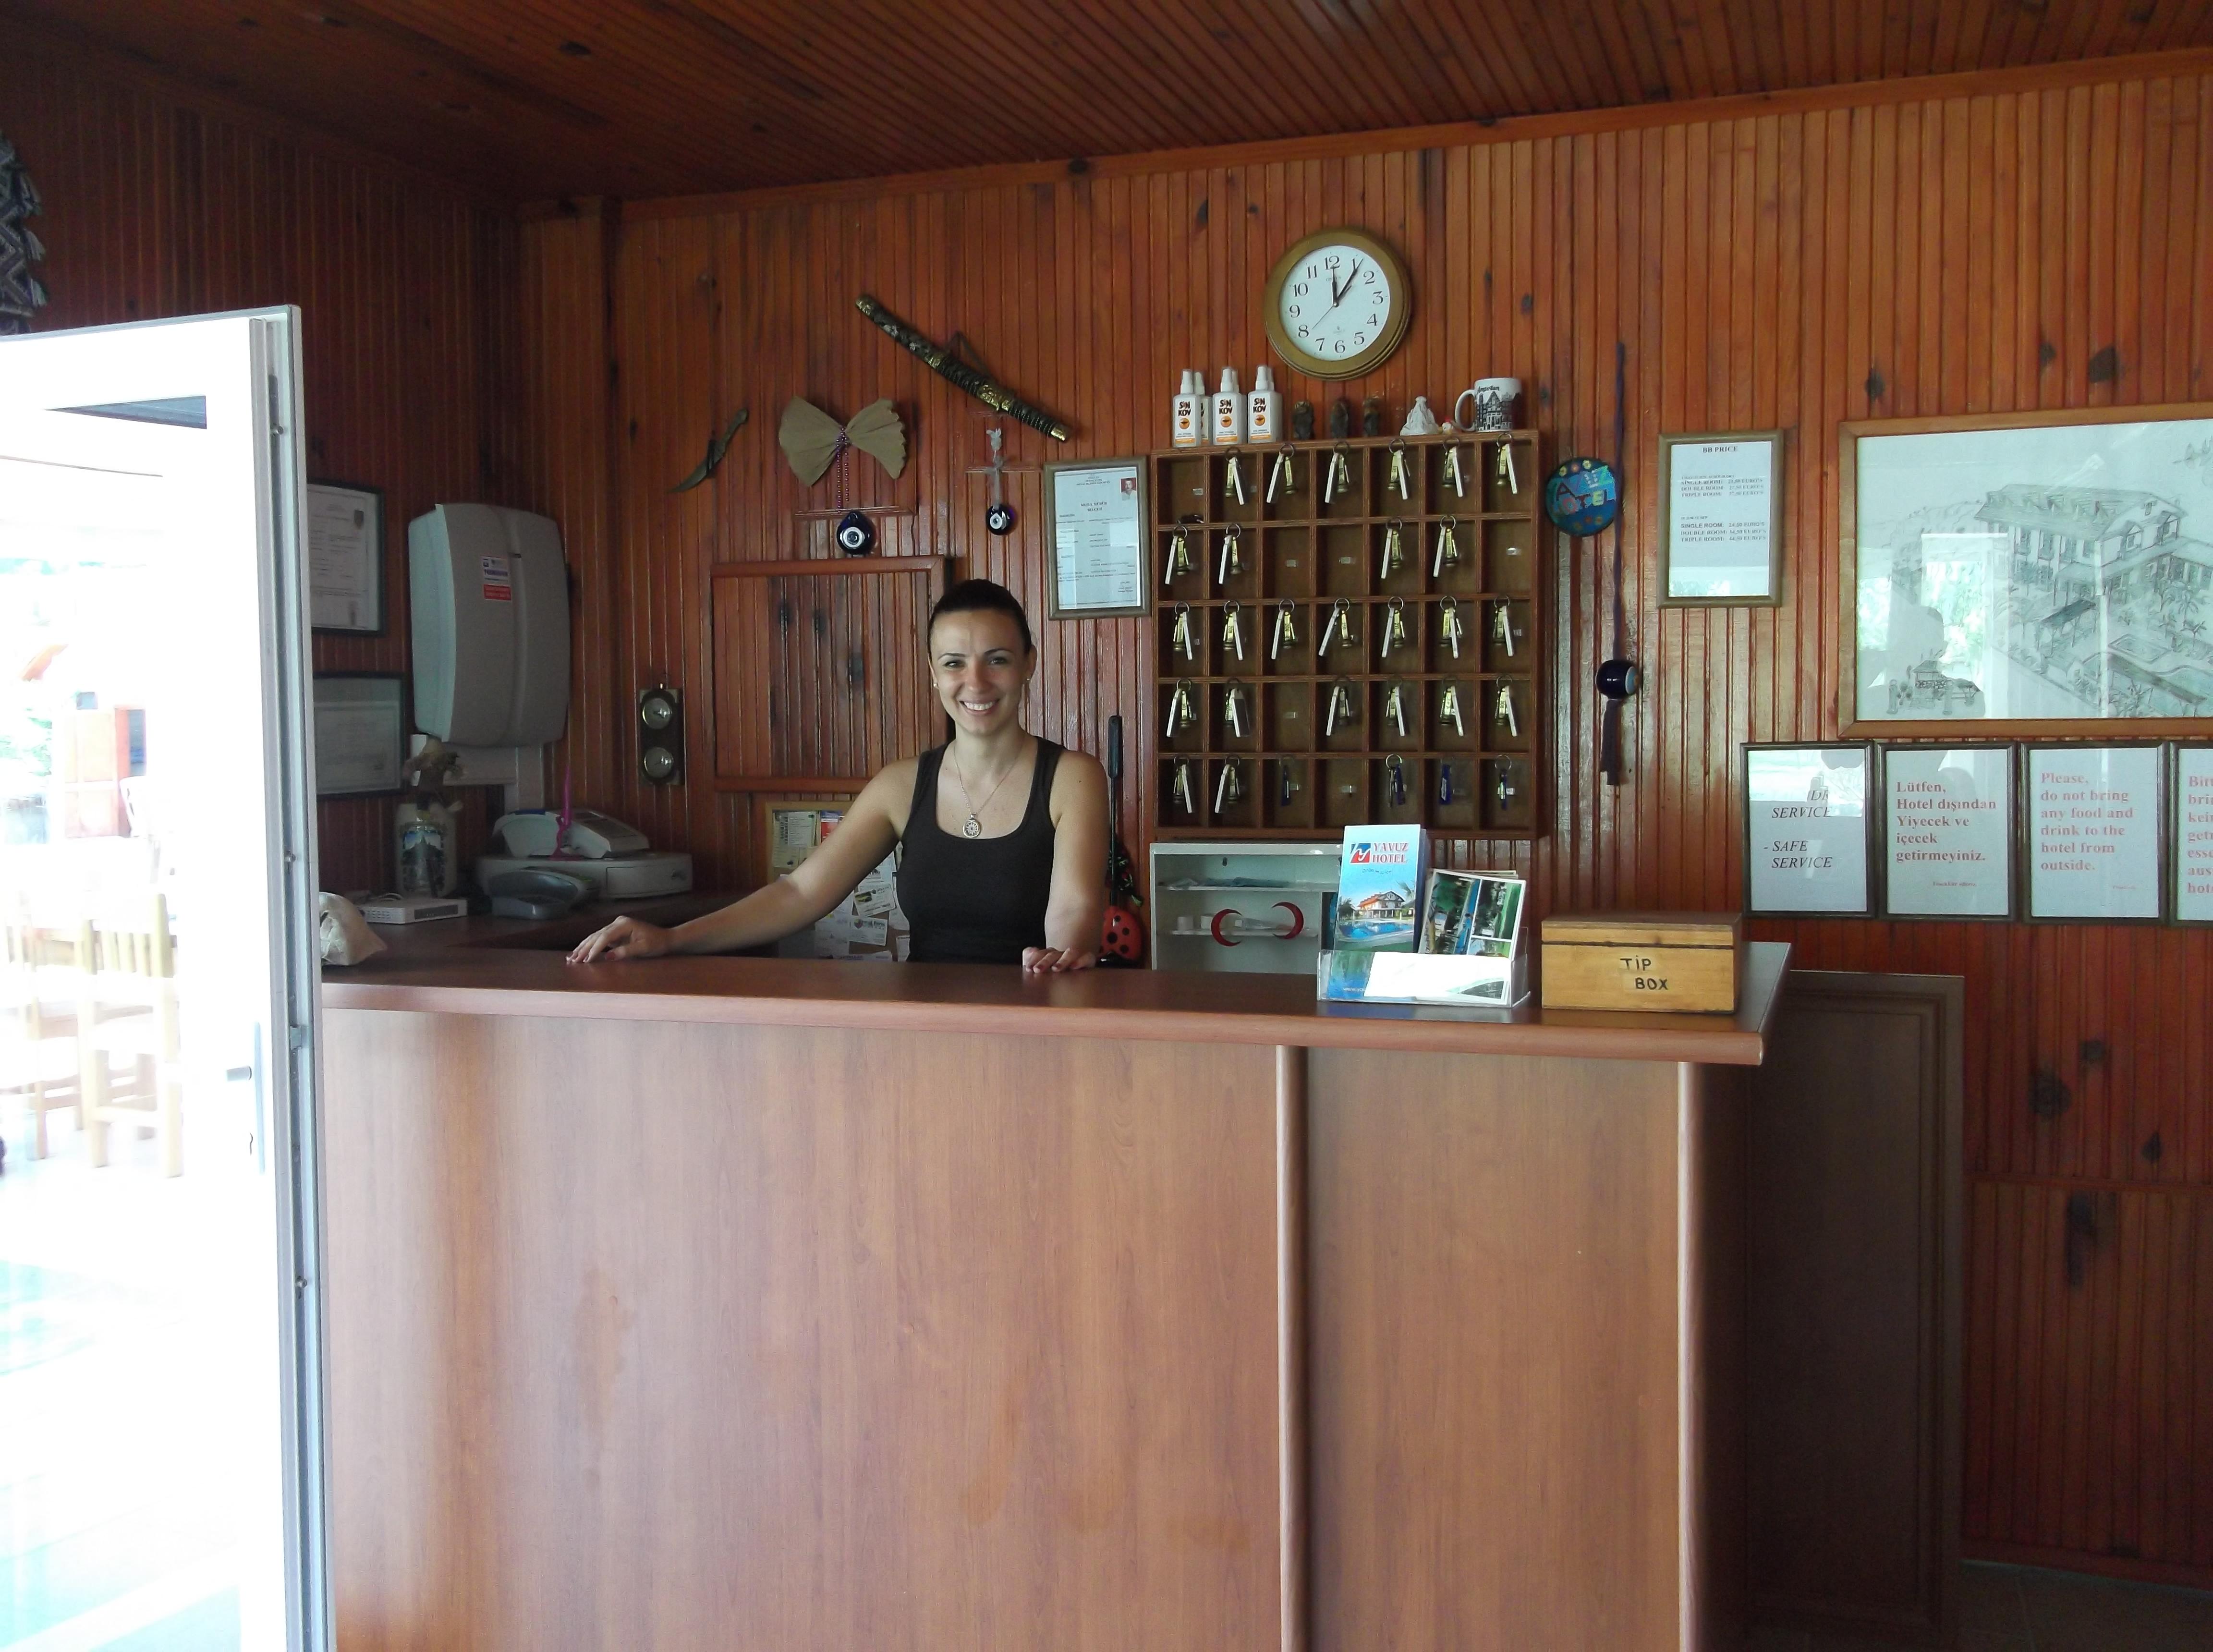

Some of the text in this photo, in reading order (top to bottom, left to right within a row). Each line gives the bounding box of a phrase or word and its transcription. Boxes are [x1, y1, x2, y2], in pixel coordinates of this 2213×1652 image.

[1325, 255, 1340, 270] 12
[1307, 265, 1317, 279] 11
[1363, 271, 1375, 284] 2
[1293, 282, 1308, 297] 10
[1372, 291, 1384, 304] 3
[1289, 304, 1301, 318] 9
[1366, 314, 1378, 327] 4
[1298, 324, 1309, 338] 8
[1315, 338, 1325, 351] 7
[1354, 331, 1364, 345] 5
[1335, 340, 1346, 353] 6
[1897, 782, 1946, 793] Lütfen,
[2041, 790, 2129, 803] do not bring
[1897, 799, 1996, 812] Hotel dışından
[2041, 808, 2133, 821] any food and
[1897, 815, 1951, 829] Yiyecek
[2041, 825, 2125, 836] drink to the
[1897, 833, 1937, 845] içecek
[1374, 843, 1408, 851] YAVUZ
[1772, 840, 1809, 852] SAFE
[2041, 842, 2115, 853] hotel from
[1373, 854, 1407, 863] HOTEL
[1772, 857, 1833, 868] SERVICE
[1897, 850, 1985, 863] getirmeyiniz.
[2041, 860, 2095, 871] outside.
[2188, 882, 2213, 893] hot
[1635, 977, 1668, 990] BOX
